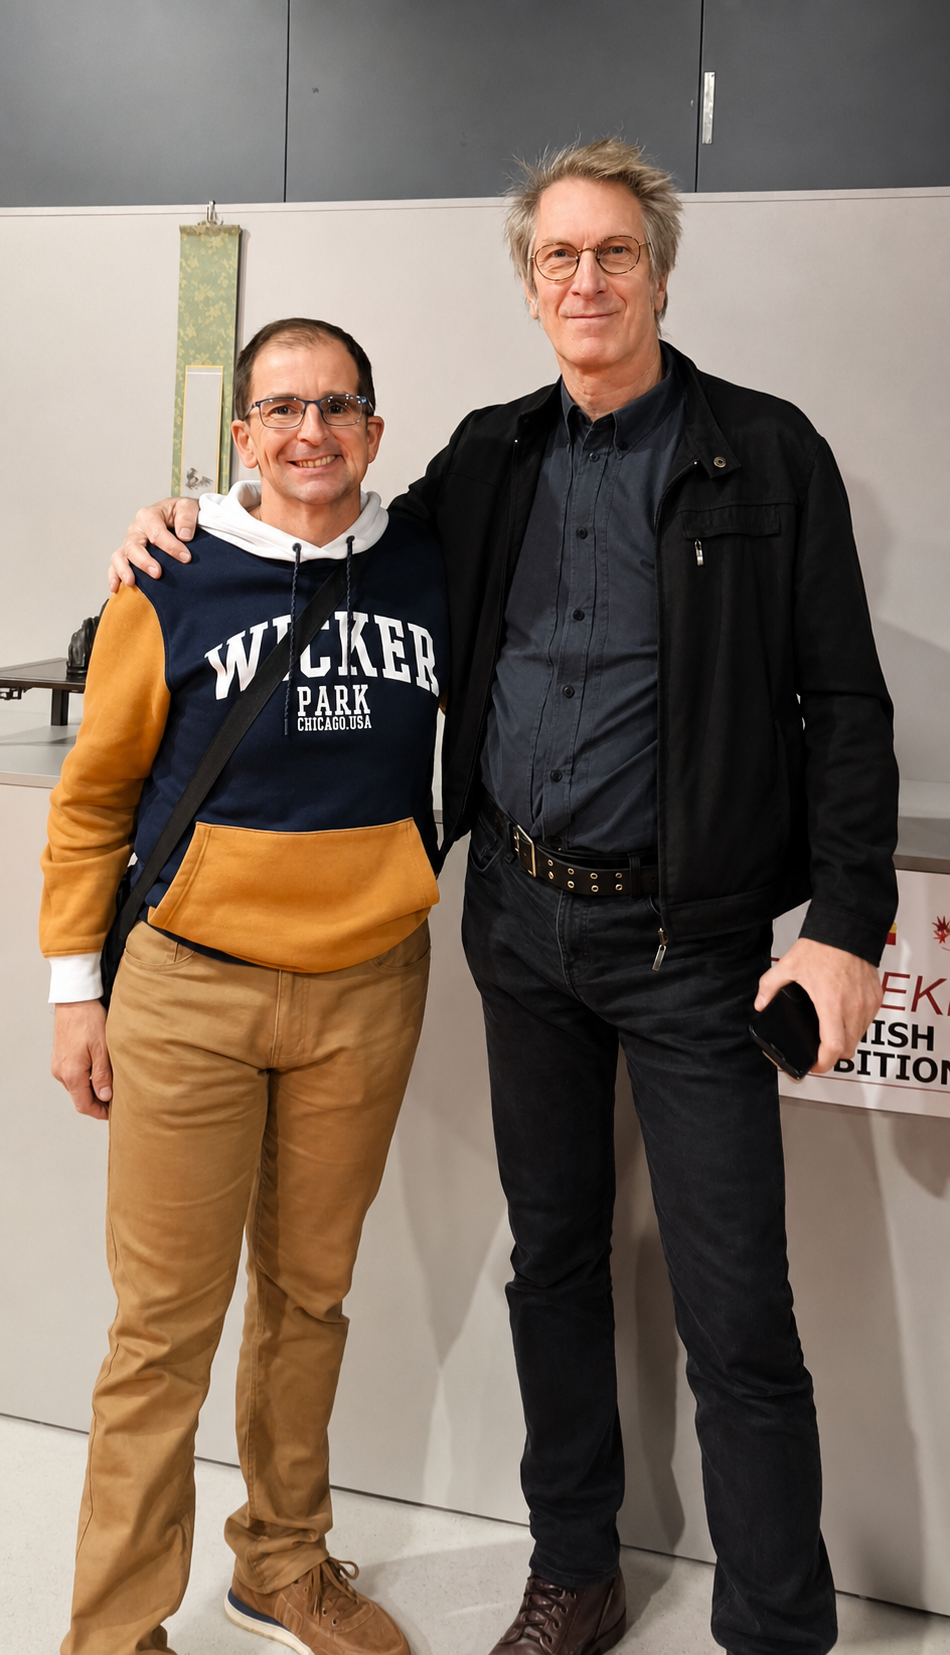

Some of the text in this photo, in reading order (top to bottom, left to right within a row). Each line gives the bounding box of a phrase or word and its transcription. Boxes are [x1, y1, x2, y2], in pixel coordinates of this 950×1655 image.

[297, 684, 370, 717] PARK
[297, 715, 372, 732] CHICAGO.USA
[880, 971, 950, 1016] EK
[861, 1019, 934, 1052] ISH
